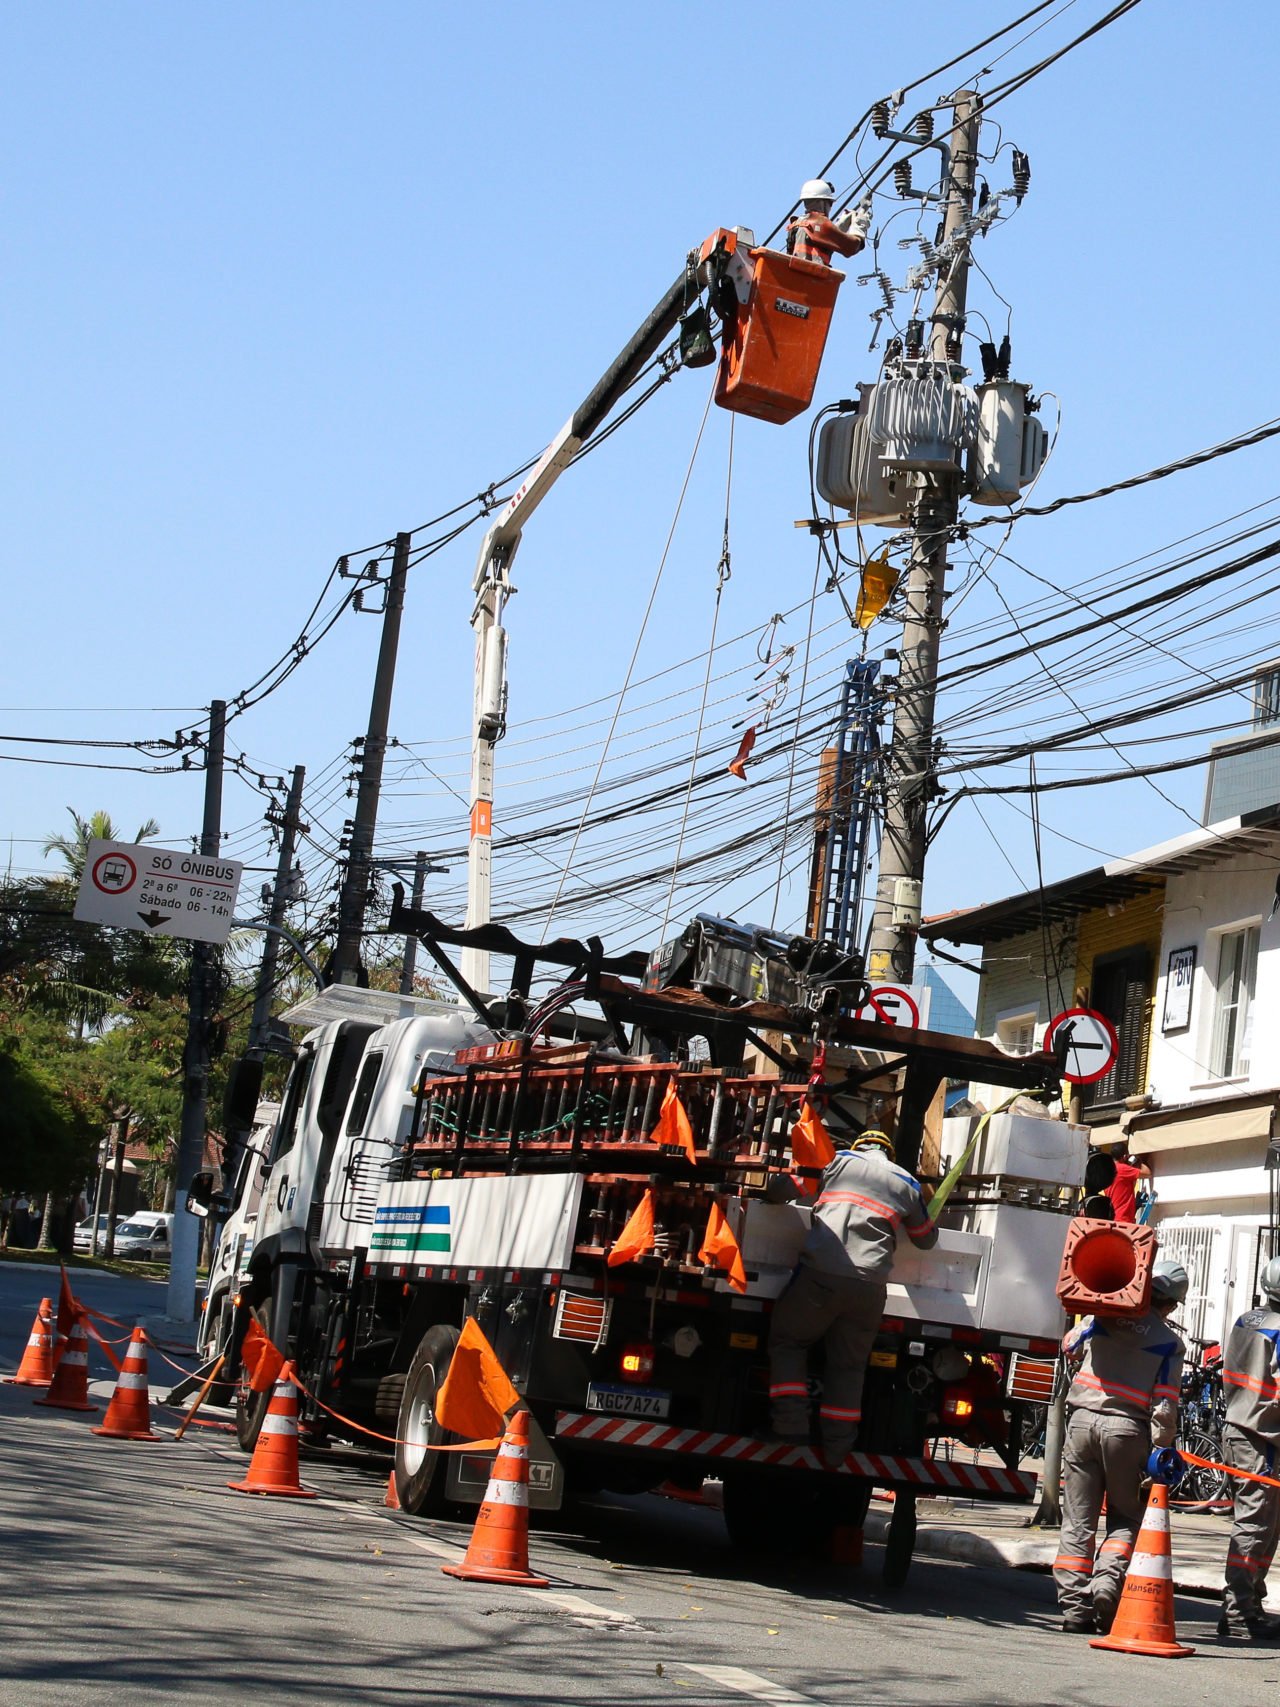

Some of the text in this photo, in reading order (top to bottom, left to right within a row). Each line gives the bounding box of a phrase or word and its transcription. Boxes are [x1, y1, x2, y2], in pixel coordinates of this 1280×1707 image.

[152, 855, 234, 880] SÓ ÔNIBUS
[157, 883, 164, 891] a
[190, 887, 203, 898] 06
[213, 890, 232, 902] 22h
[140, 893, 182, 909] Sábado
[187, 901, 200, 912] 06
[211, 905, 229, 917] 14h
[596, 1392, 661, 1414] RGC7A74
